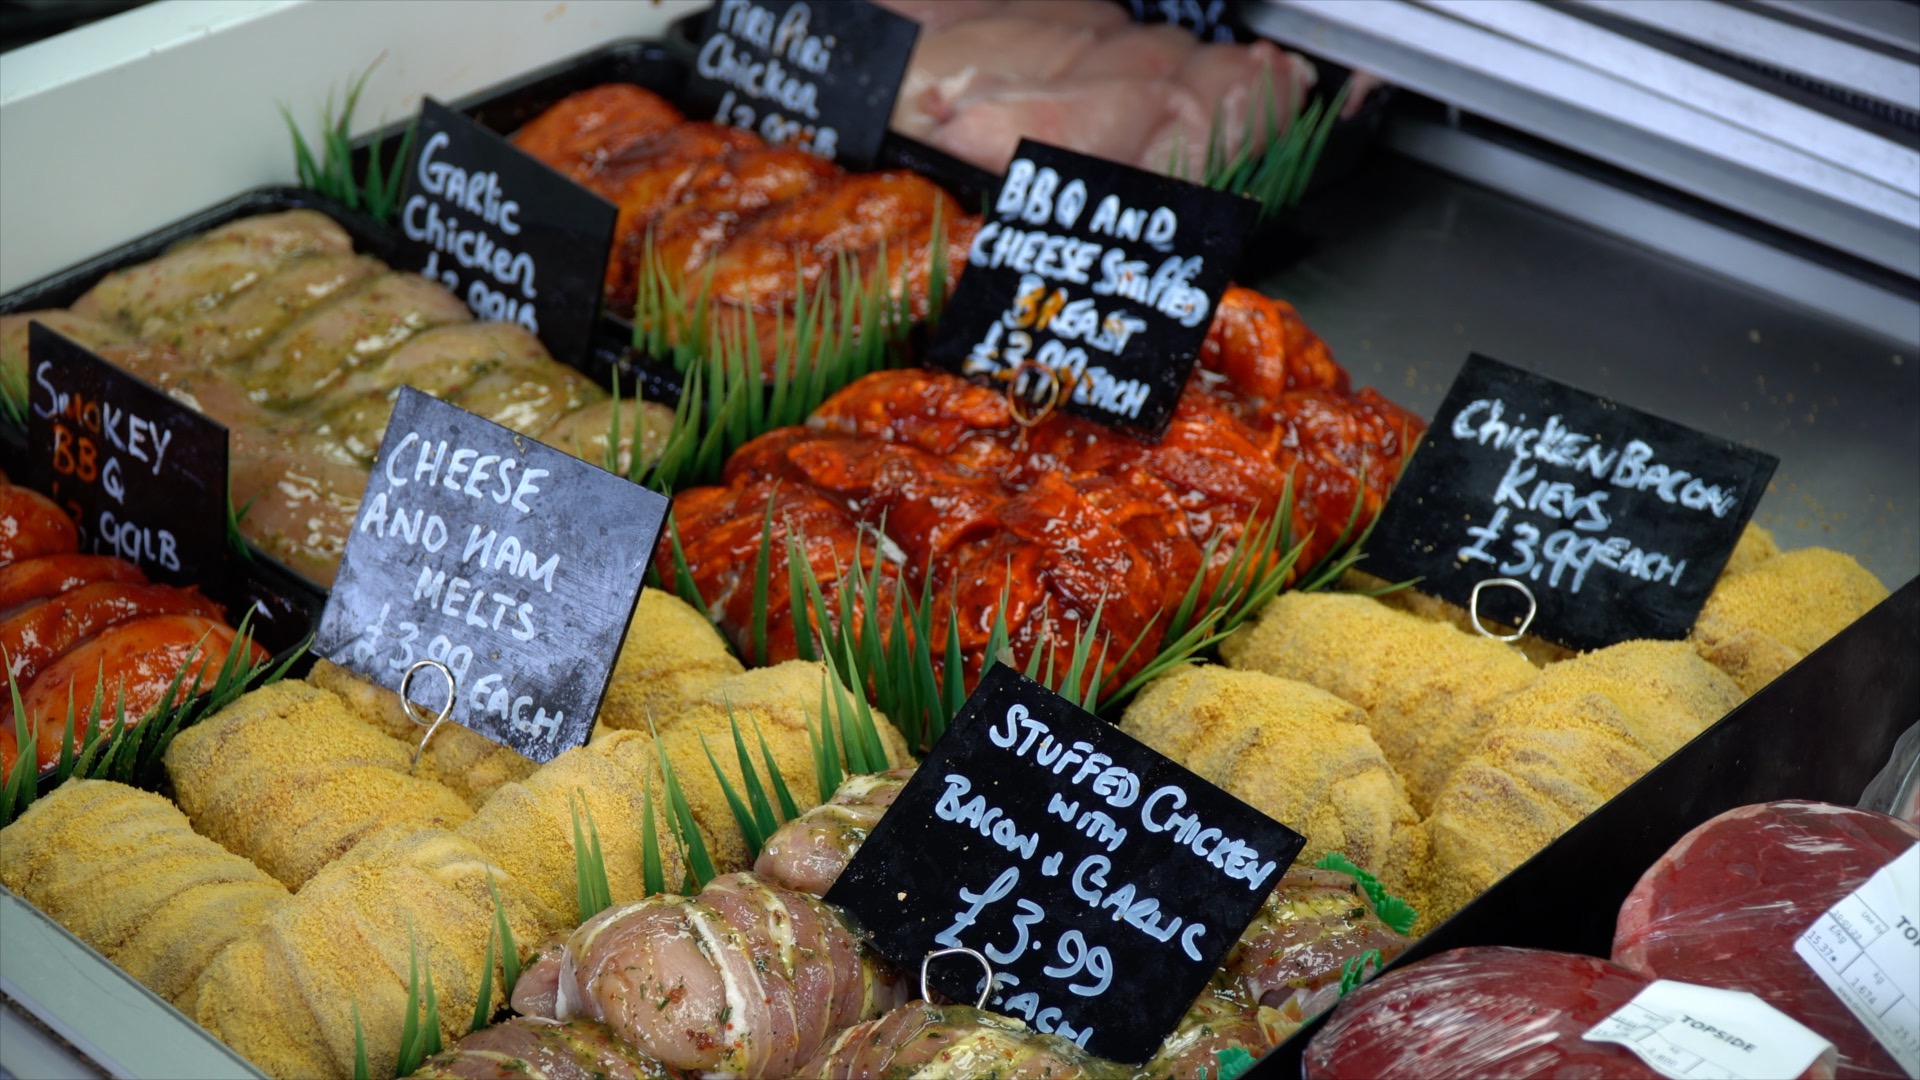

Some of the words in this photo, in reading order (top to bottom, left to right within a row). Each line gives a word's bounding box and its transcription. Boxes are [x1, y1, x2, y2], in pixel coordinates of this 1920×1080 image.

[403, 194, 537, 298] Chicken
[995, 158, 1088, 229] BBQ
[1089, 194, 1178, 252] AND
[969, 221, 1103, 285] CHEESE
[385, 432, 549, 513] CHEESE
[360, 492, 449, 553] AND
[462, 524, 560, 593] HAM
[413, 566, 535, 641] MELTS
[989, 704, 1139, 807] STUFFED
[935, 774, 1039, 860] BACON
[1072, 854, 1206, 961] GARLIC
[1048, 793, 1127, 851] WITH
[934, 866, 1112, 997] £3.99
[1680, 1013, 1757, 1054] TOPSIDE
